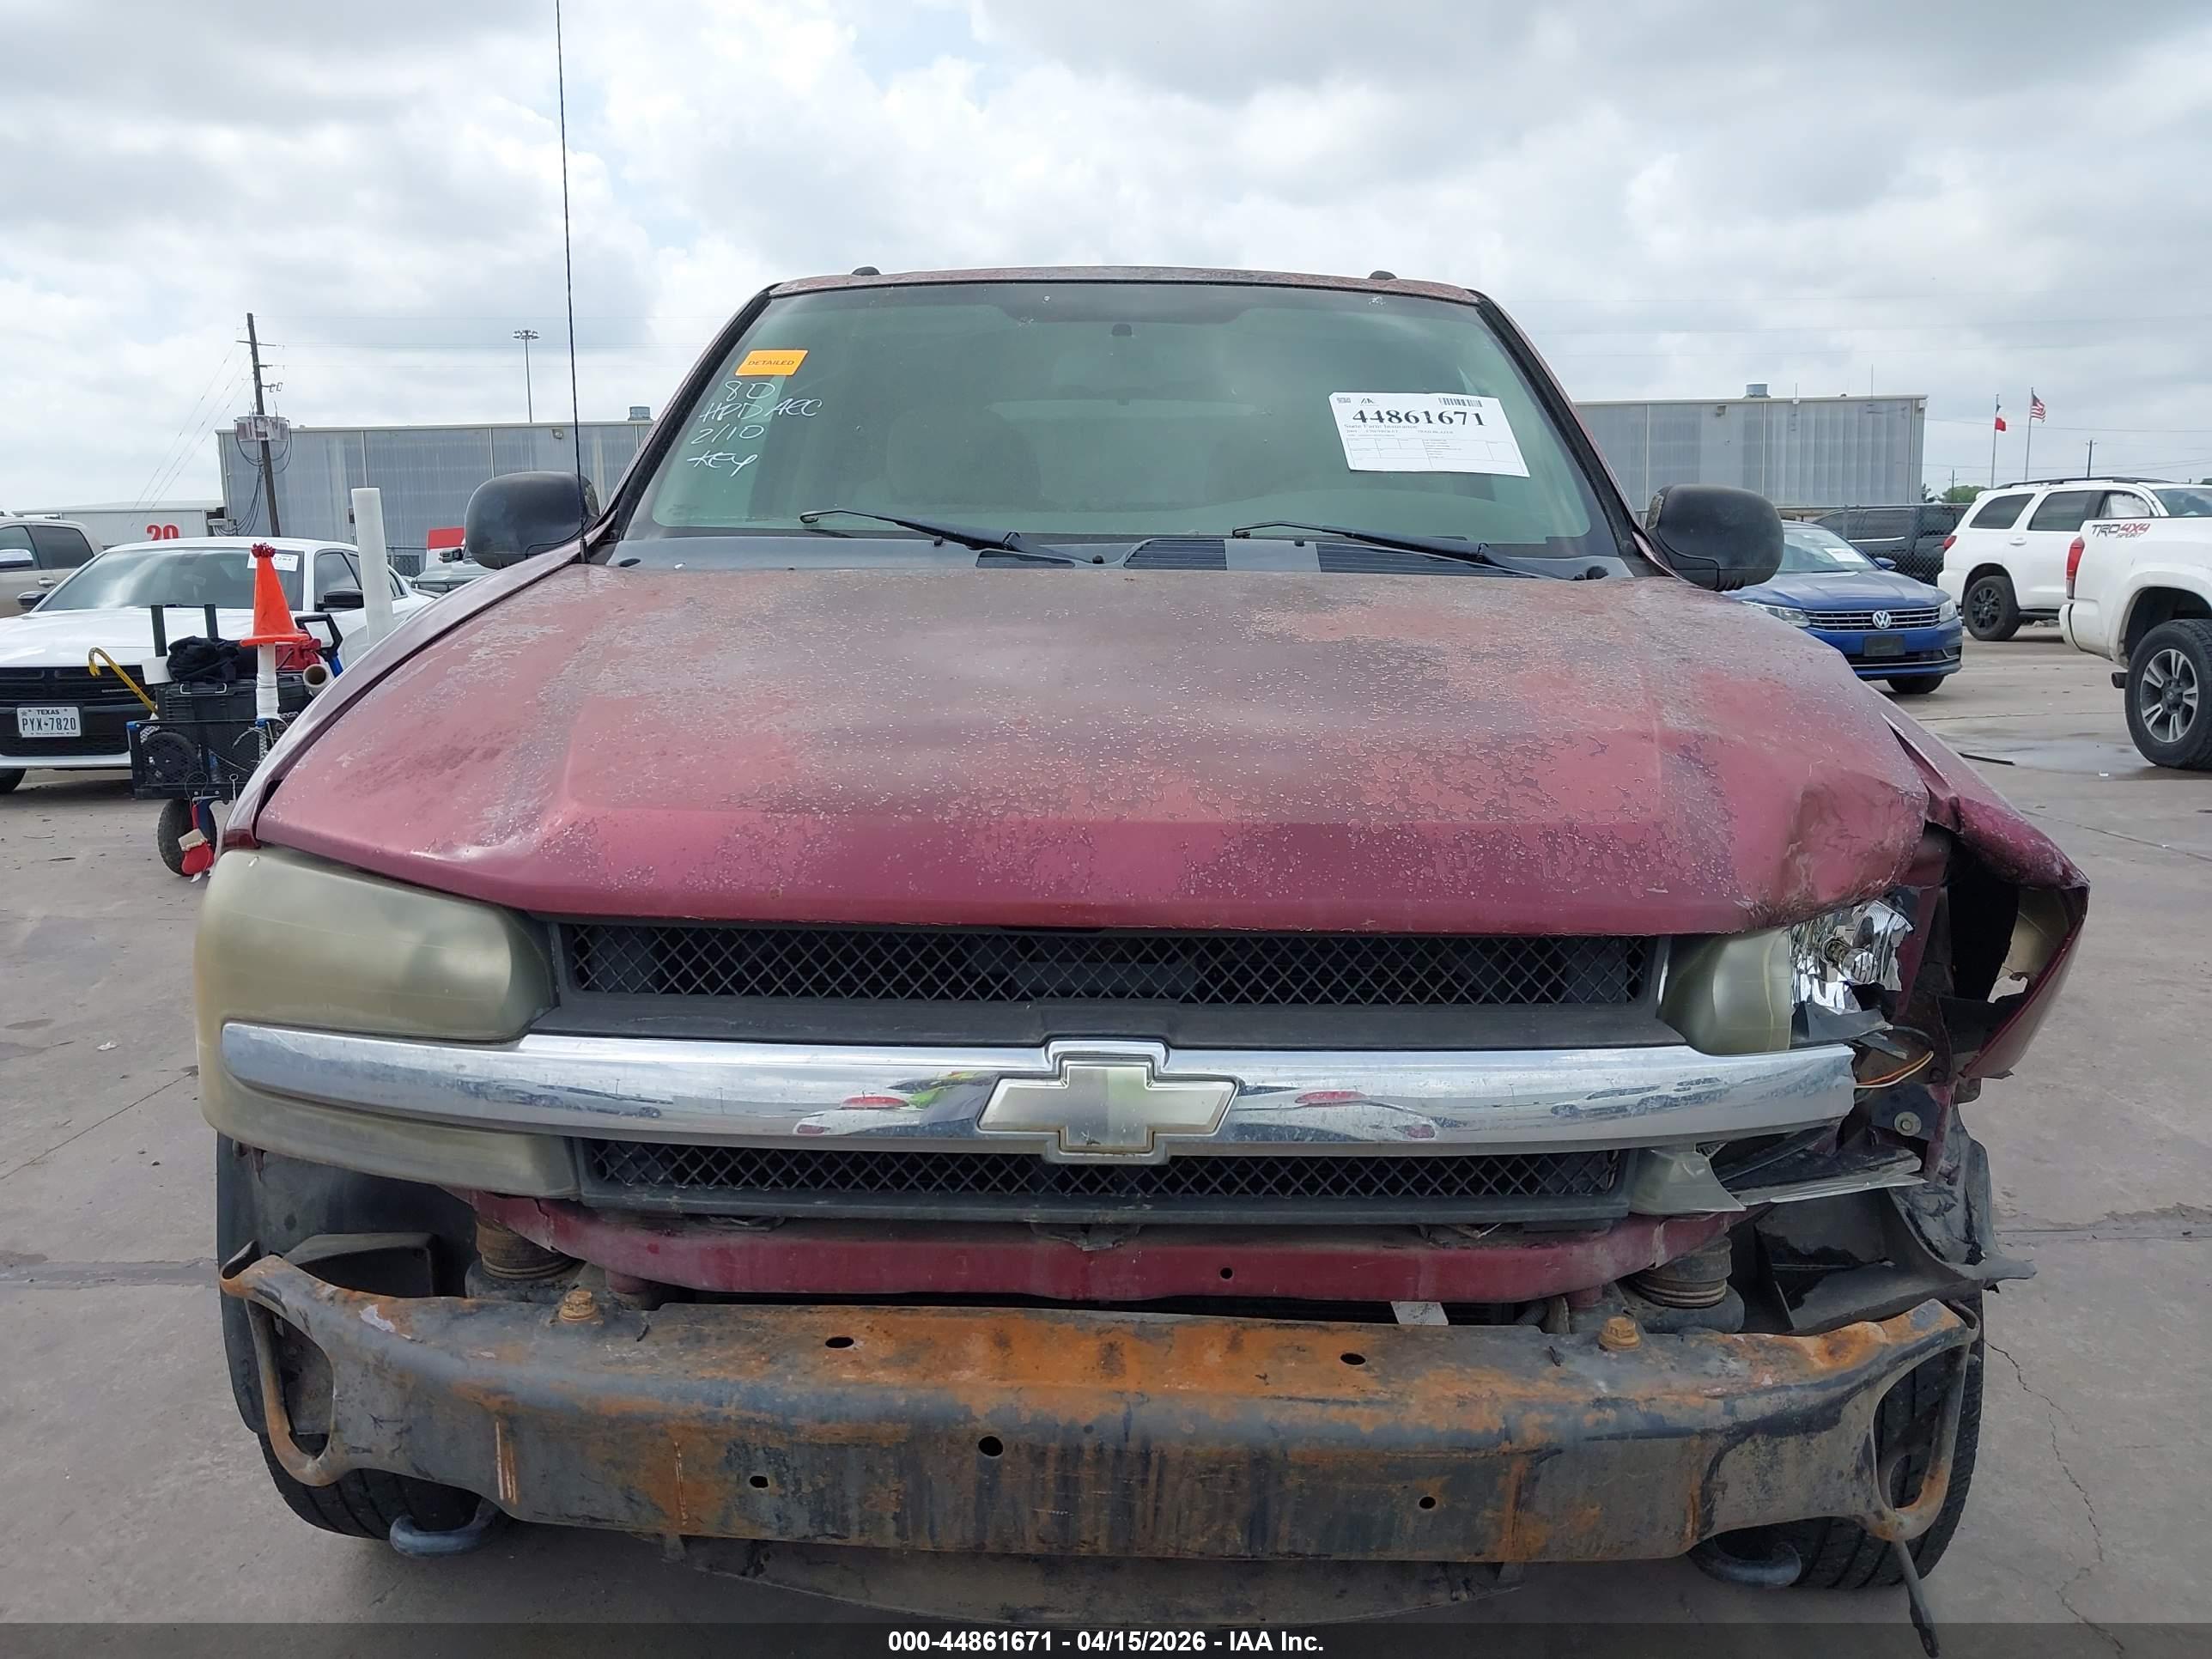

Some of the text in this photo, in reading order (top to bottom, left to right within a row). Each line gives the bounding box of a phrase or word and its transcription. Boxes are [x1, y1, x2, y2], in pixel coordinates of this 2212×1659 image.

[1352, 410, 1487, 426] 44861671
[690, 423, 764, 444] 2/10
[146, 524, 179, 541] 20
[2092, 523, 2121, 538] TRD
